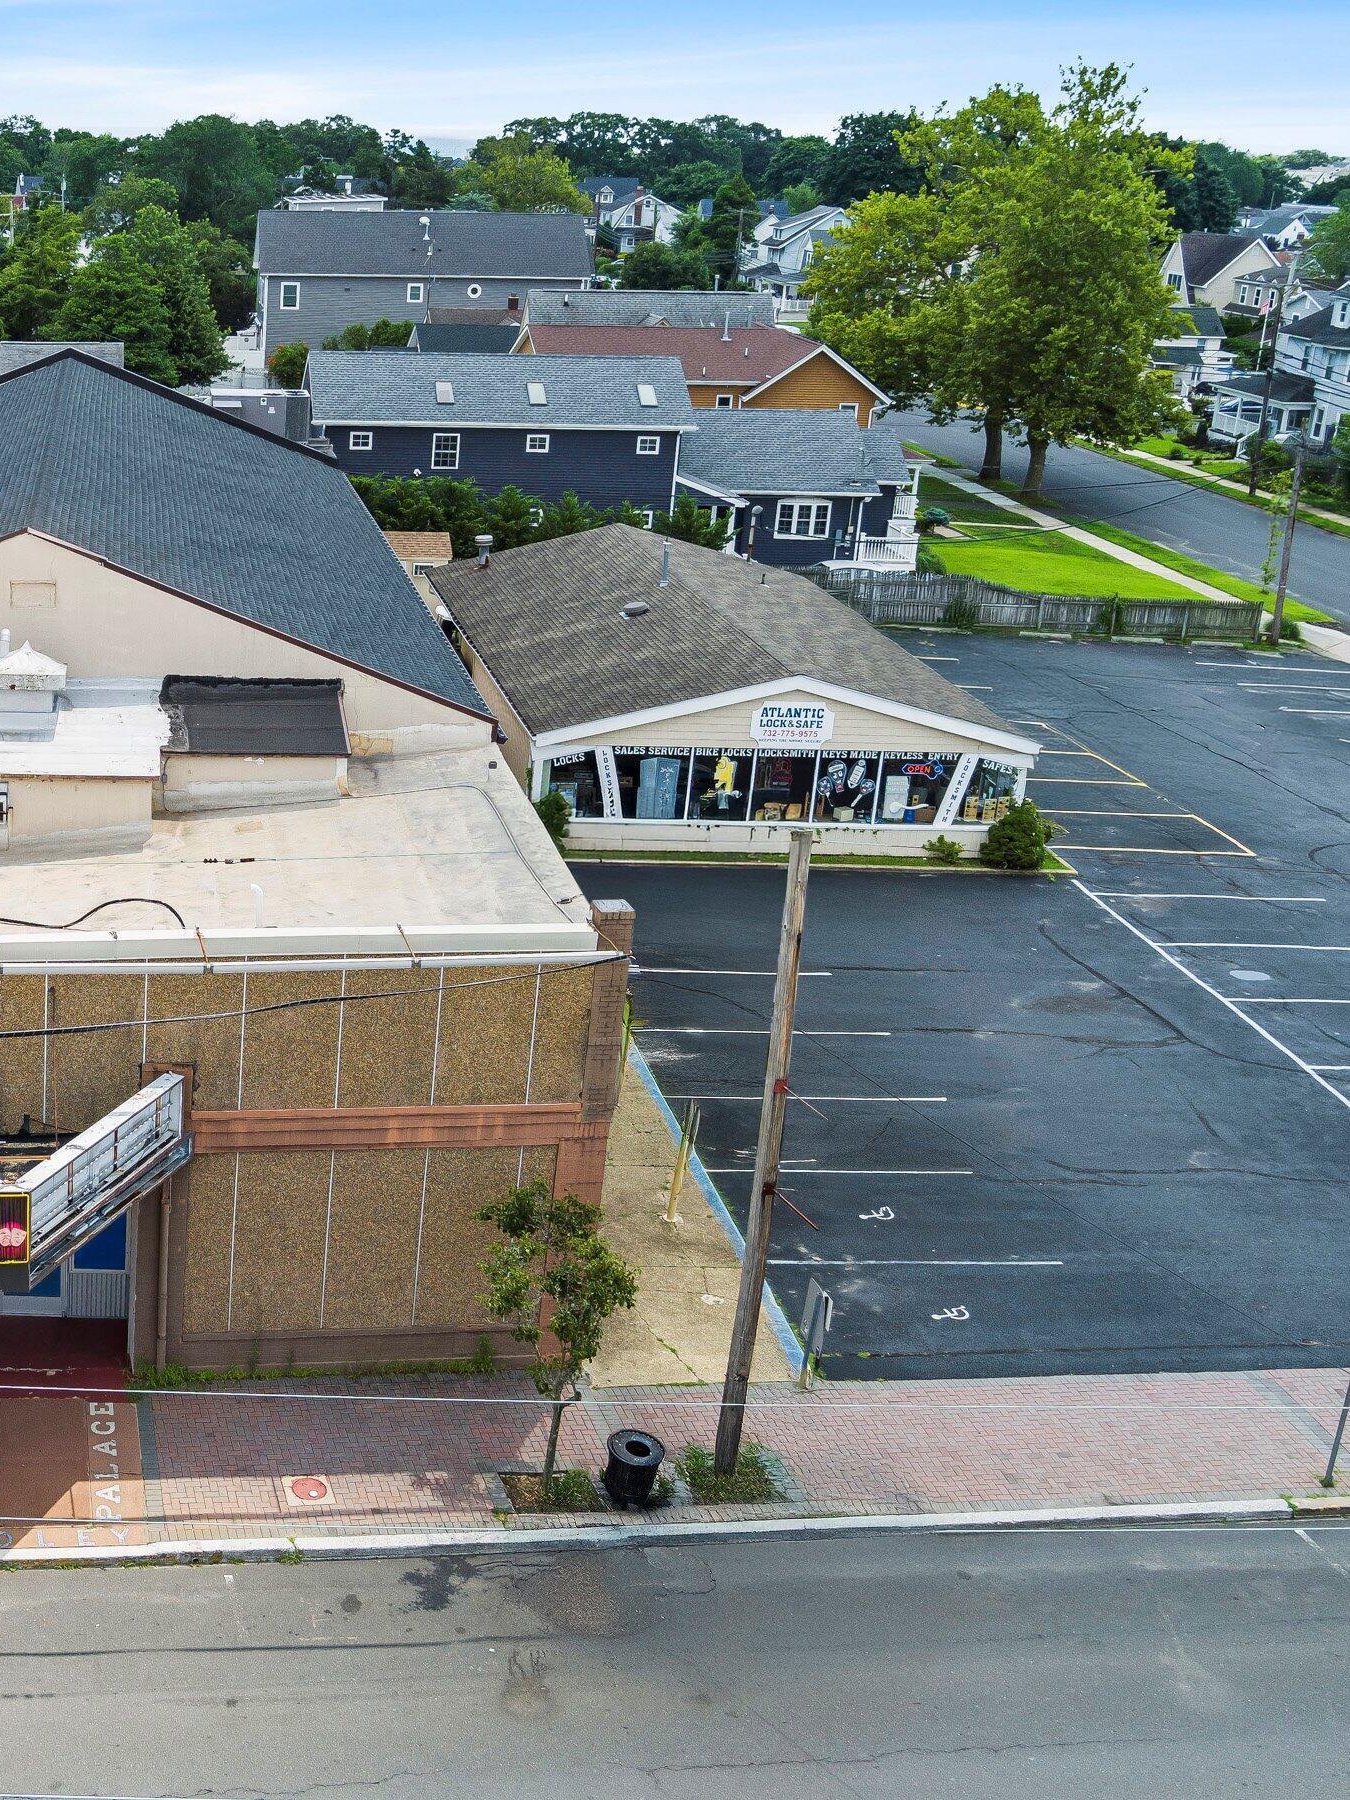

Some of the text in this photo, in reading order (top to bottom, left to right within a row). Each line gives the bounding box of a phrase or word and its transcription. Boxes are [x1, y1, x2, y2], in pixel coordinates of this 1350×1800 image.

[760, 707, 825, 719] ATLANTIC
[762, 729, 818, 738] 732-775-9575
[614, 746, 690, 756] SALES SERVICE
[695, 748, 753, 757] BIKE LOCKS
[758, 749, 815, 758] LOCKSMITH
[822, 751, 879, 759] KEYS MADE
[553, 752, 586, 767] LOCKS
[884, 752, 959, 761] KEYLESS ENTRY
[907, 765, 931, 773] OPEN
[982, 760, 1014, 774] SAFES
[941, 757, 972, 823] LOCKSMITH
[89, 1401, 122, 1521] PALACE
